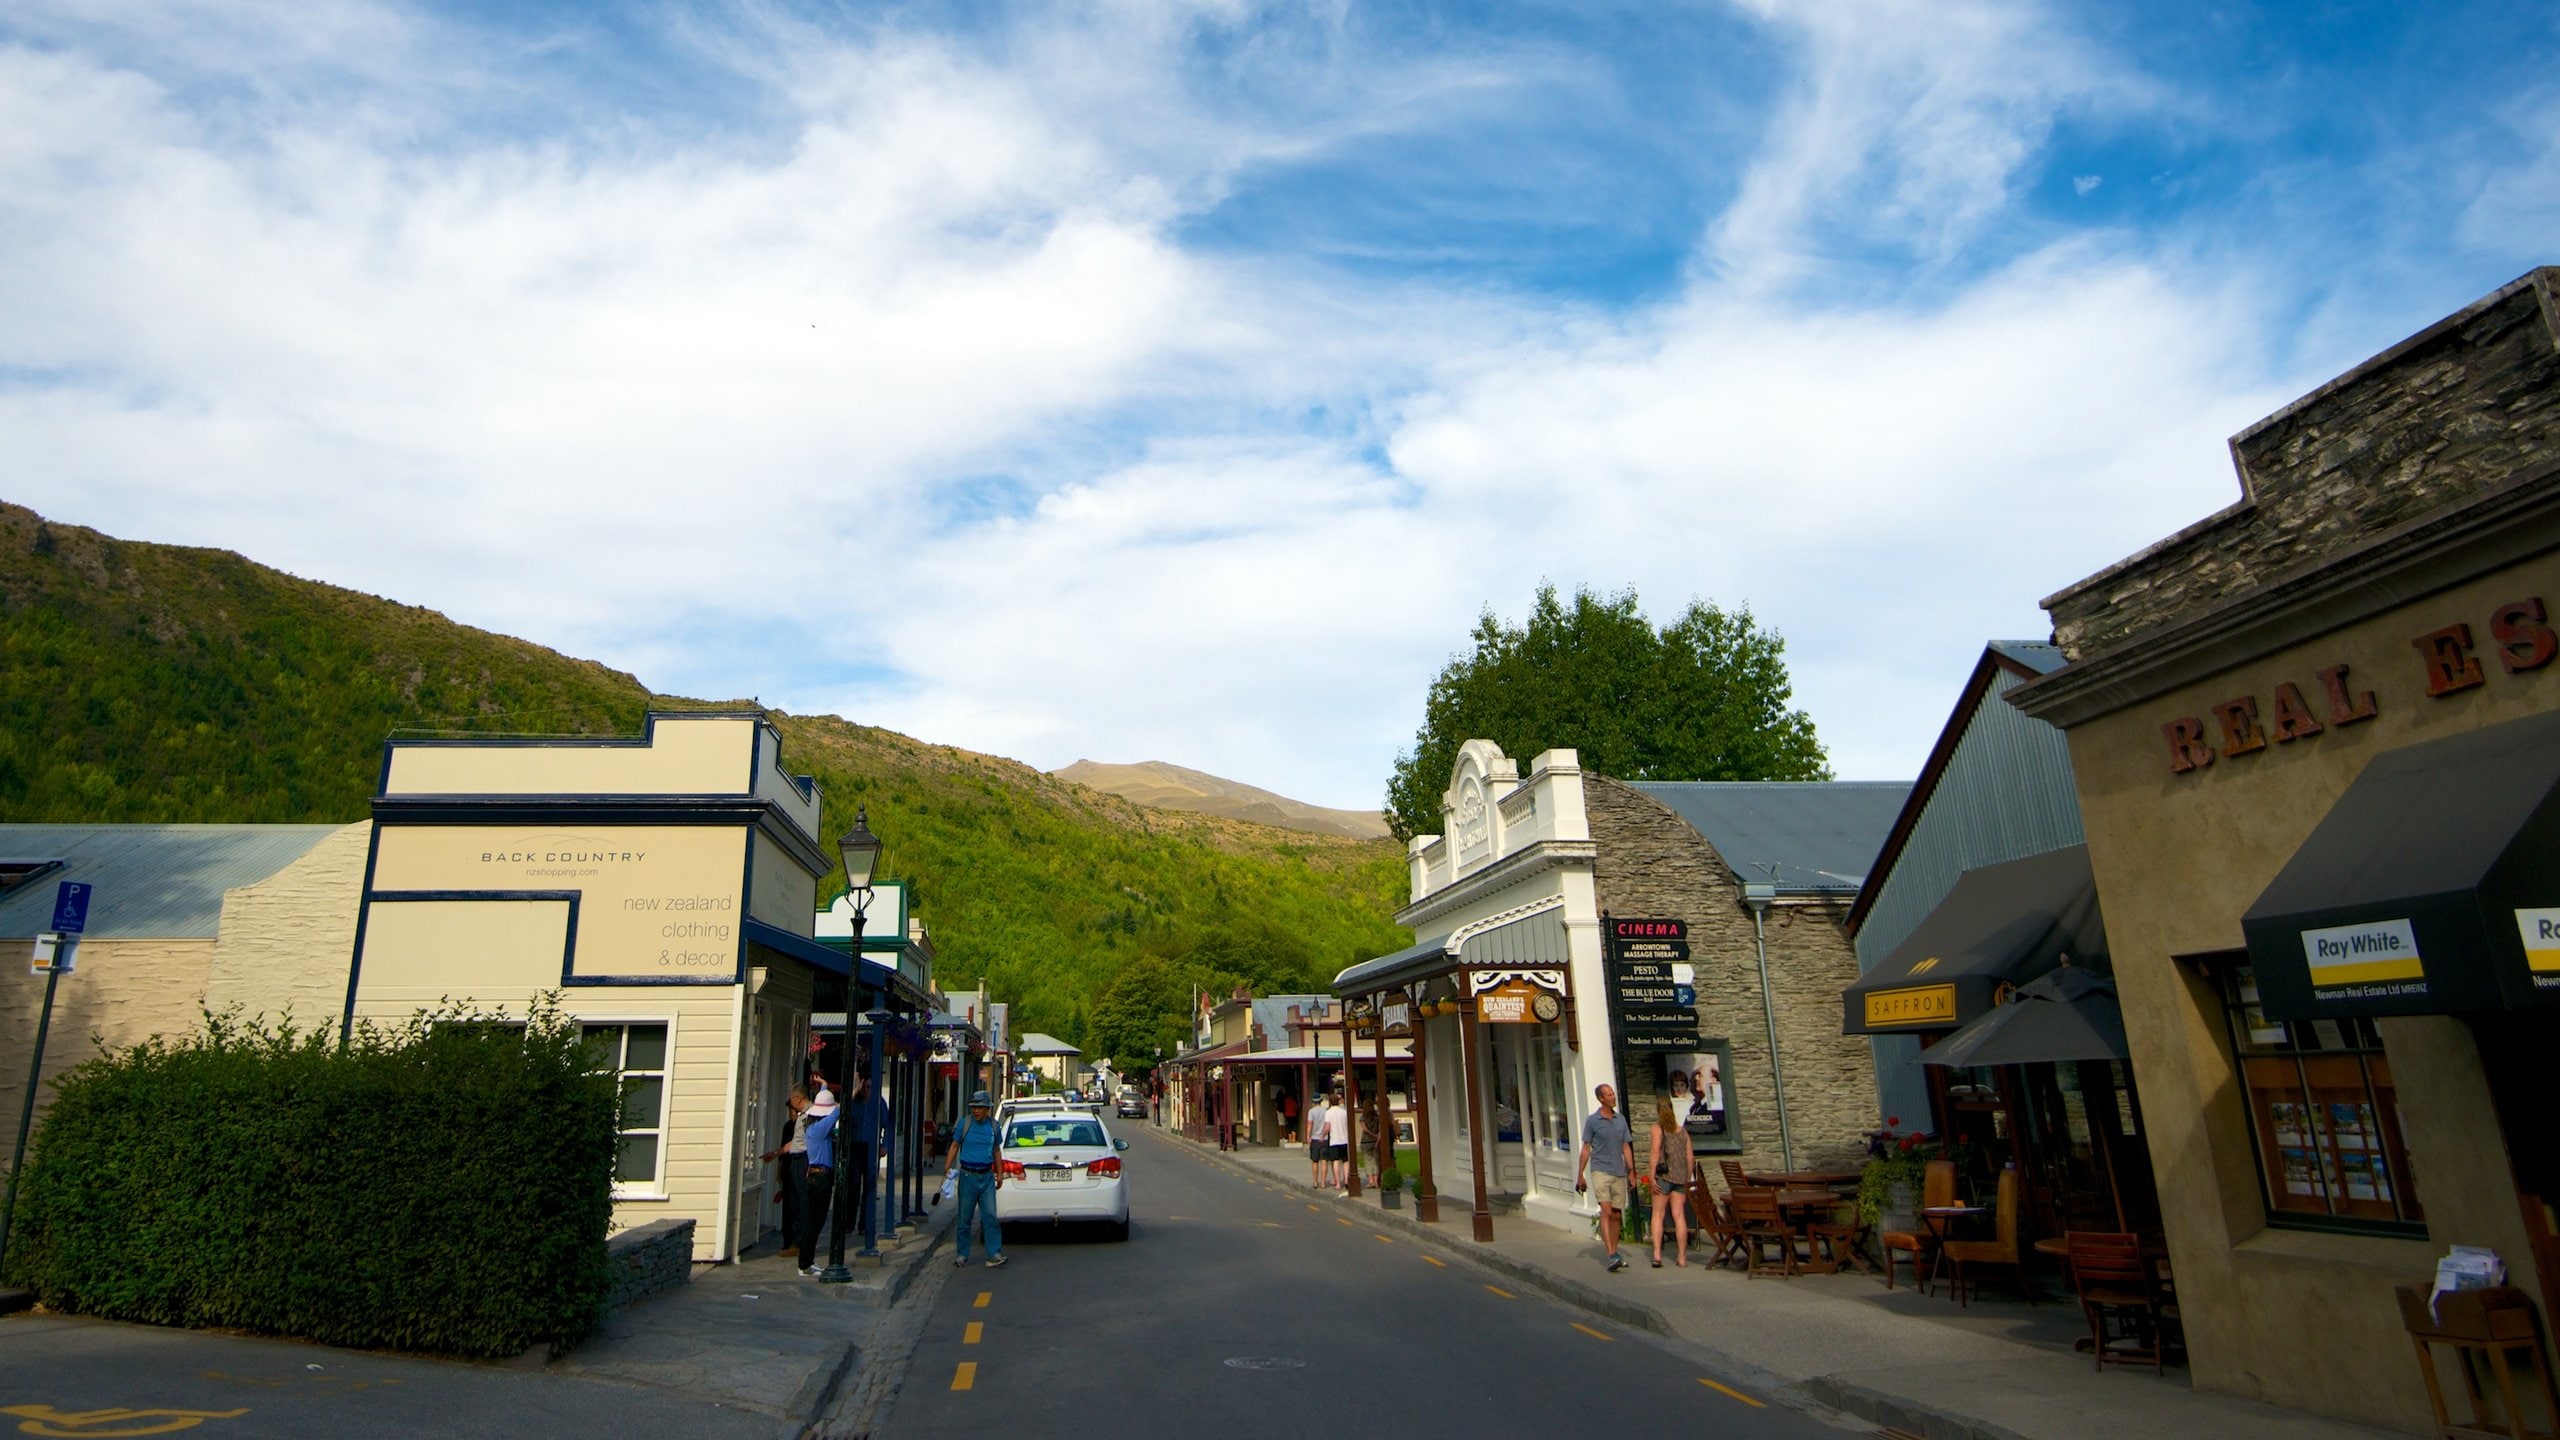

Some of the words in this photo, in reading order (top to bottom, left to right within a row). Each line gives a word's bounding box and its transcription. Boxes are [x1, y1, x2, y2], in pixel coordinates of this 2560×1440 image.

[2161, 664, 2378, 774] REAL
[2411, 596, 2559, 699] ES
[481, 852, 537, 862] BACK
[546, 852, 647, 862] COUNTRY
[525, 867, 599, 878] nzshopping.com
[69, 884, 80, 898] P
[623, 897, 660, 911] new
[665, 895, 732, 911] zealand
[661, 922, 730, 942] clothing
[1617, 923, 1678, 935] CINEMA
[1631, 943, 1671, 951] ARROWTOWN
[2317, 937, 2348, 958] Ray
[2351, 931, 2400, 953] White
[658, 950, 670, 966] &
[675, 950, 727, 966] decor
[1633, 965, 1659, 975] PESTO
[1621, 988, 1635, 997] THE
[1636, 988, 1653, 997] BLUE
[1654, 988, 1675, 997] DOOR
[2314, 989, 2346, 1000] Newman
[2346, 986, 2363, 999] Real
[2363, 984, 2388, 997] Estate
[2388, 983, 2400, 995] Ltd
[1873, 996, 1945, 1016] SAFFRON
[1627, 1037, 1651, 1045] Nadene
[1652, 1037, 1672, 1045] Milne
[1673, 1037, 1698, 1047] Gallery
